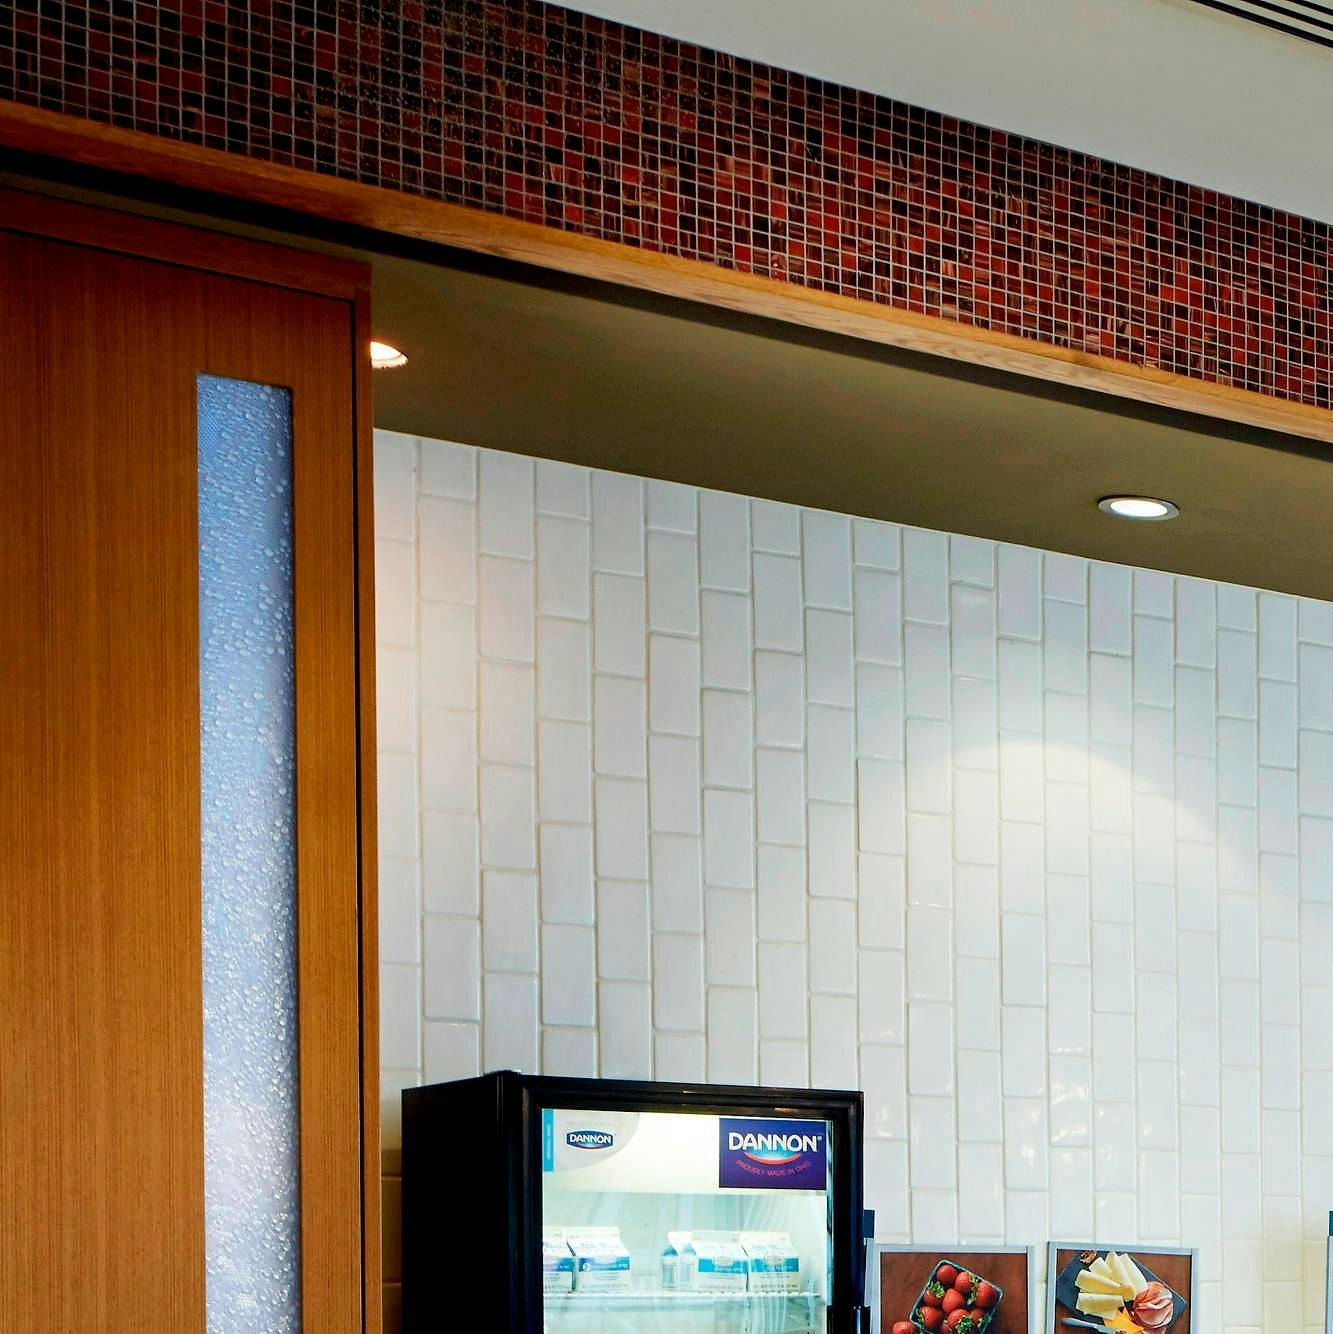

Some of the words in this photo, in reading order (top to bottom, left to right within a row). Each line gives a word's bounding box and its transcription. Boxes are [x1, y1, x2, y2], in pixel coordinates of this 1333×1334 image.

[569, 1133, 612, 1144] DANNON
[728, 1132, 818, 1152] DANNON
[736, 1159, 766, 1175] PROUDLY
